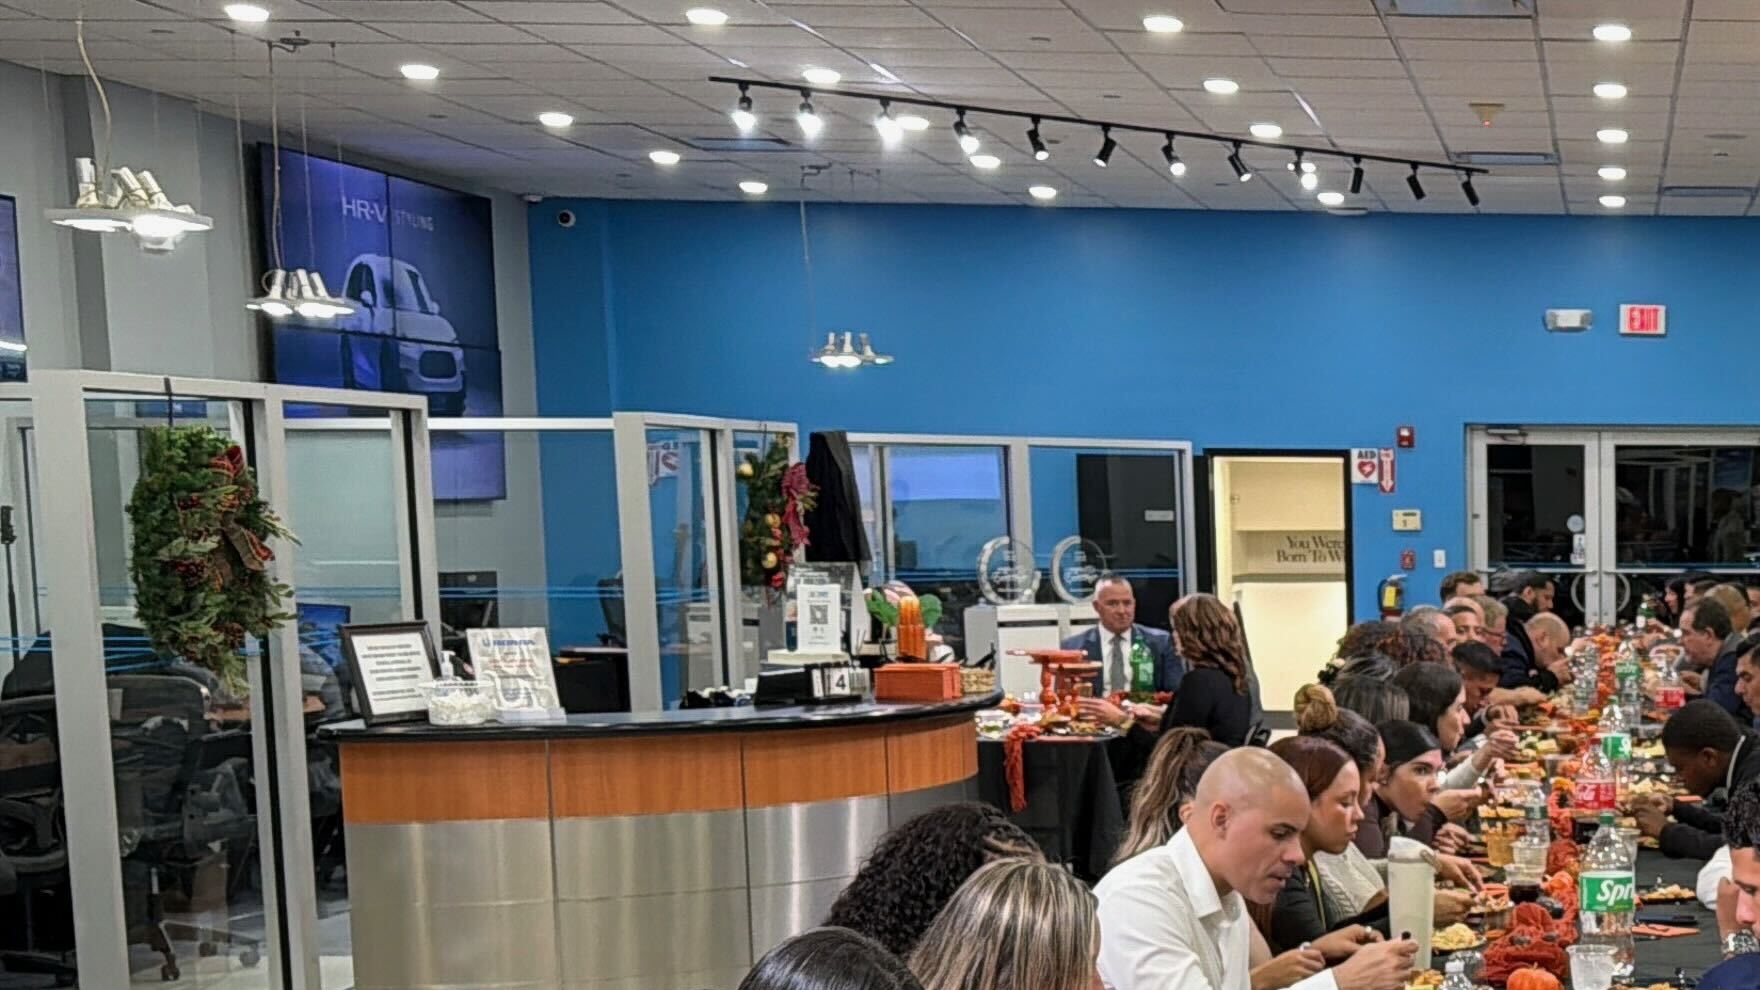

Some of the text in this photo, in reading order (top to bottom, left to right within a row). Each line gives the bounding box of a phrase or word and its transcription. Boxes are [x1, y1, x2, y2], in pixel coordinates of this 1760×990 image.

[1357, 450, 1377, 459] AED
[1286, 535, 1310, 549] You
[1276, 549, 1307, 563] Born
[836, 674, 847, 690] 4
